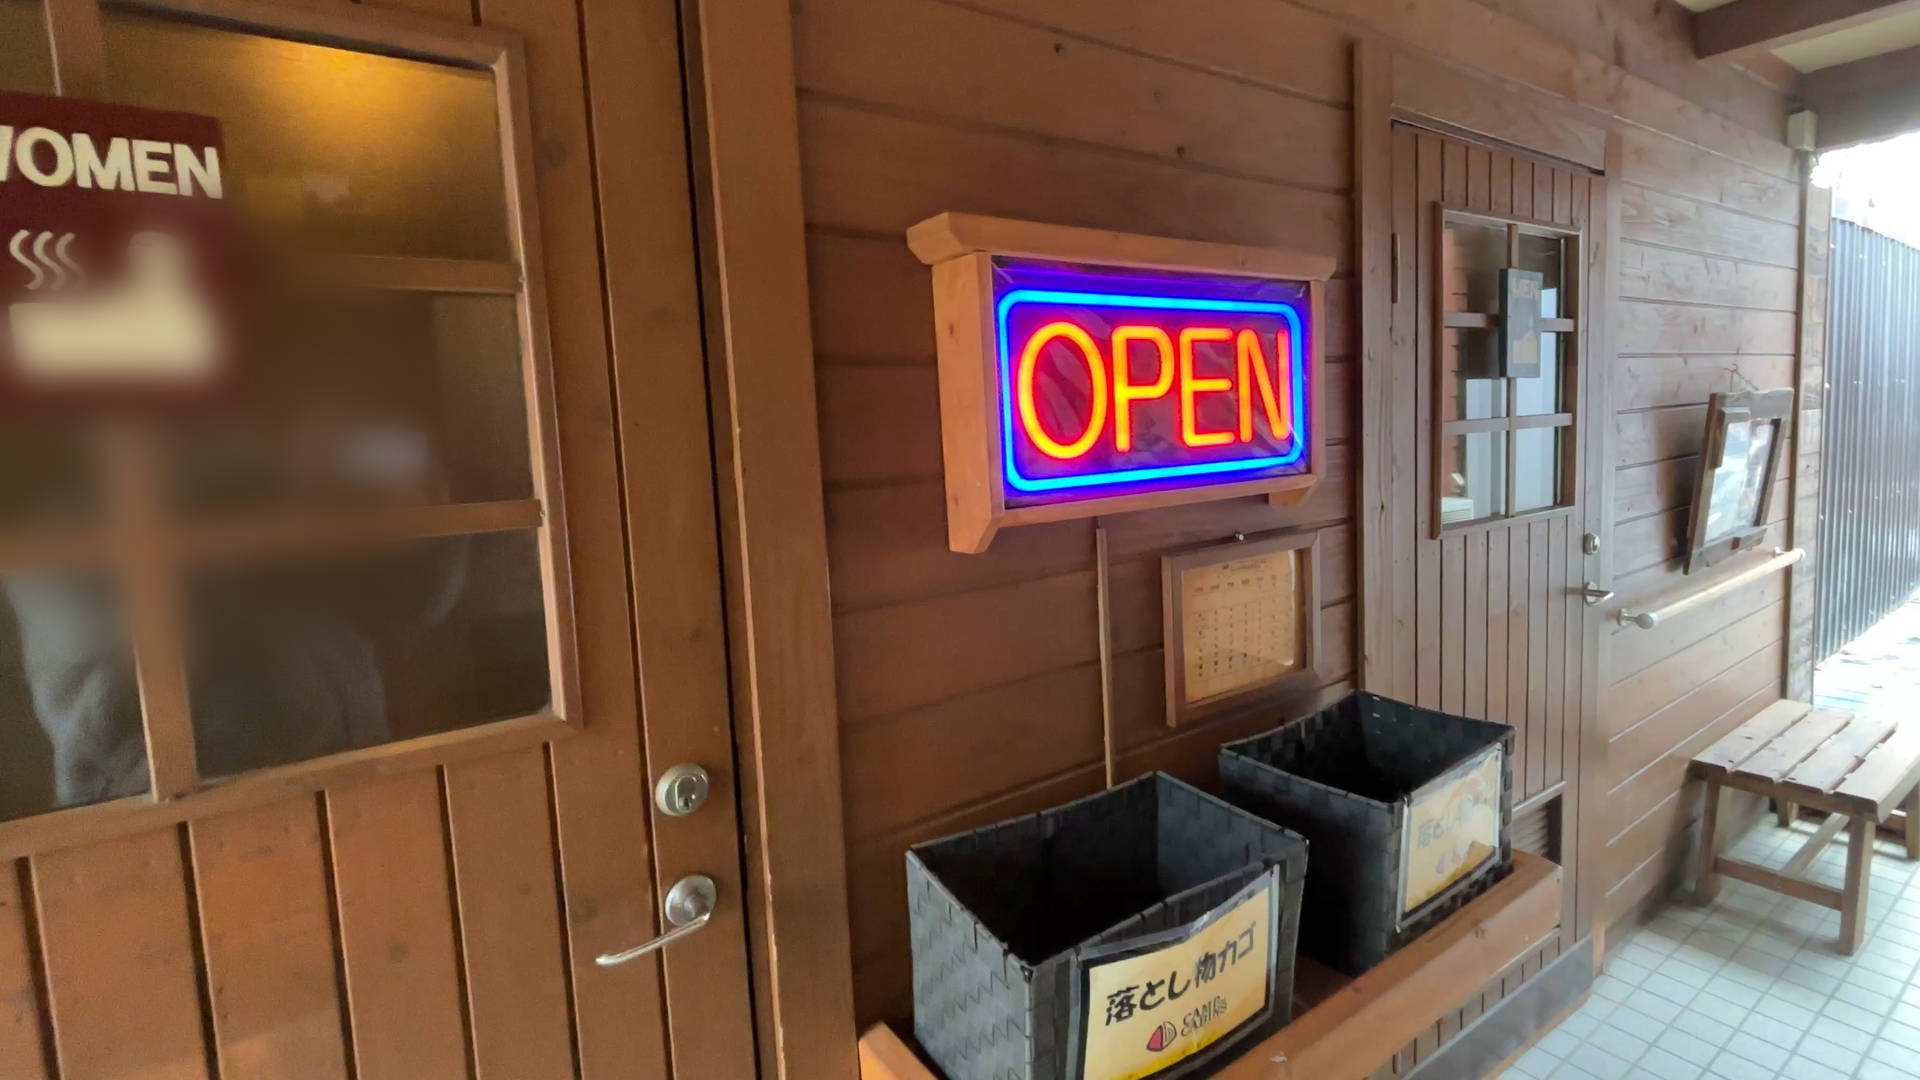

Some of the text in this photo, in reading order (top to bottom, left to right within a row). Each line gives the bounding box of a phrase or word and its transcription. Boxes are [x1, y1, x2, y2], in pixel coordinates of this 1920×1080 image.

[0, 125, 223, 199] OMEN
[1018, 321, 1292, 459] OPEN
[1105, 922, 1257, 1026] 落とし物カゴ
